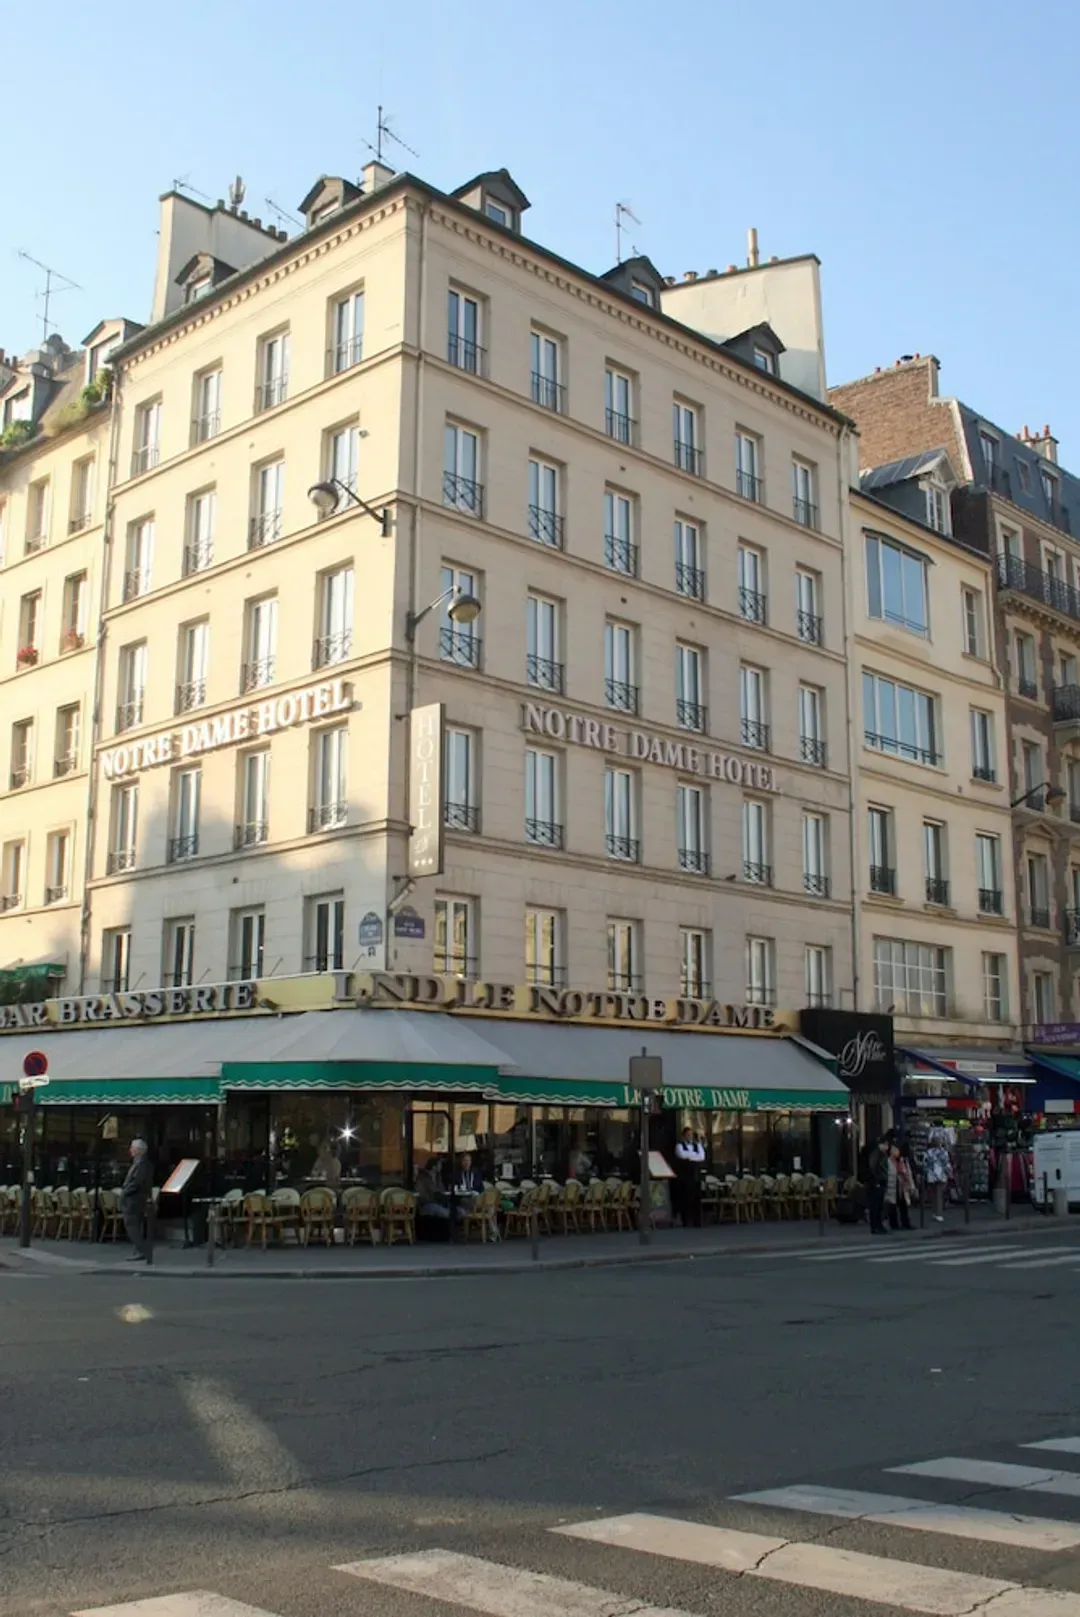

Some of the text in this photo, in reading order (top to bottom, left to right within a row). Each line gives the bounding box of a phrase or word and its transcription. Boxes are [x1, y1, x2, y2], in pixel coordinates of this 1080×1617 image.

[100, 680, 351, 777] NOTRE DAME HOTEL
[522, 702, 782, 793] NOTRE DAME HOTEL
[415, 715, 434, 829] HOTEL
[59, 983, 256, 1022] BRASSERIE
[456, 979, 515, 1010] LE
[529, 985, 668, 1020] NOTRE
[676, 999, 775, 1029] DAME
[711, 1089, 752, 1109] DAME
